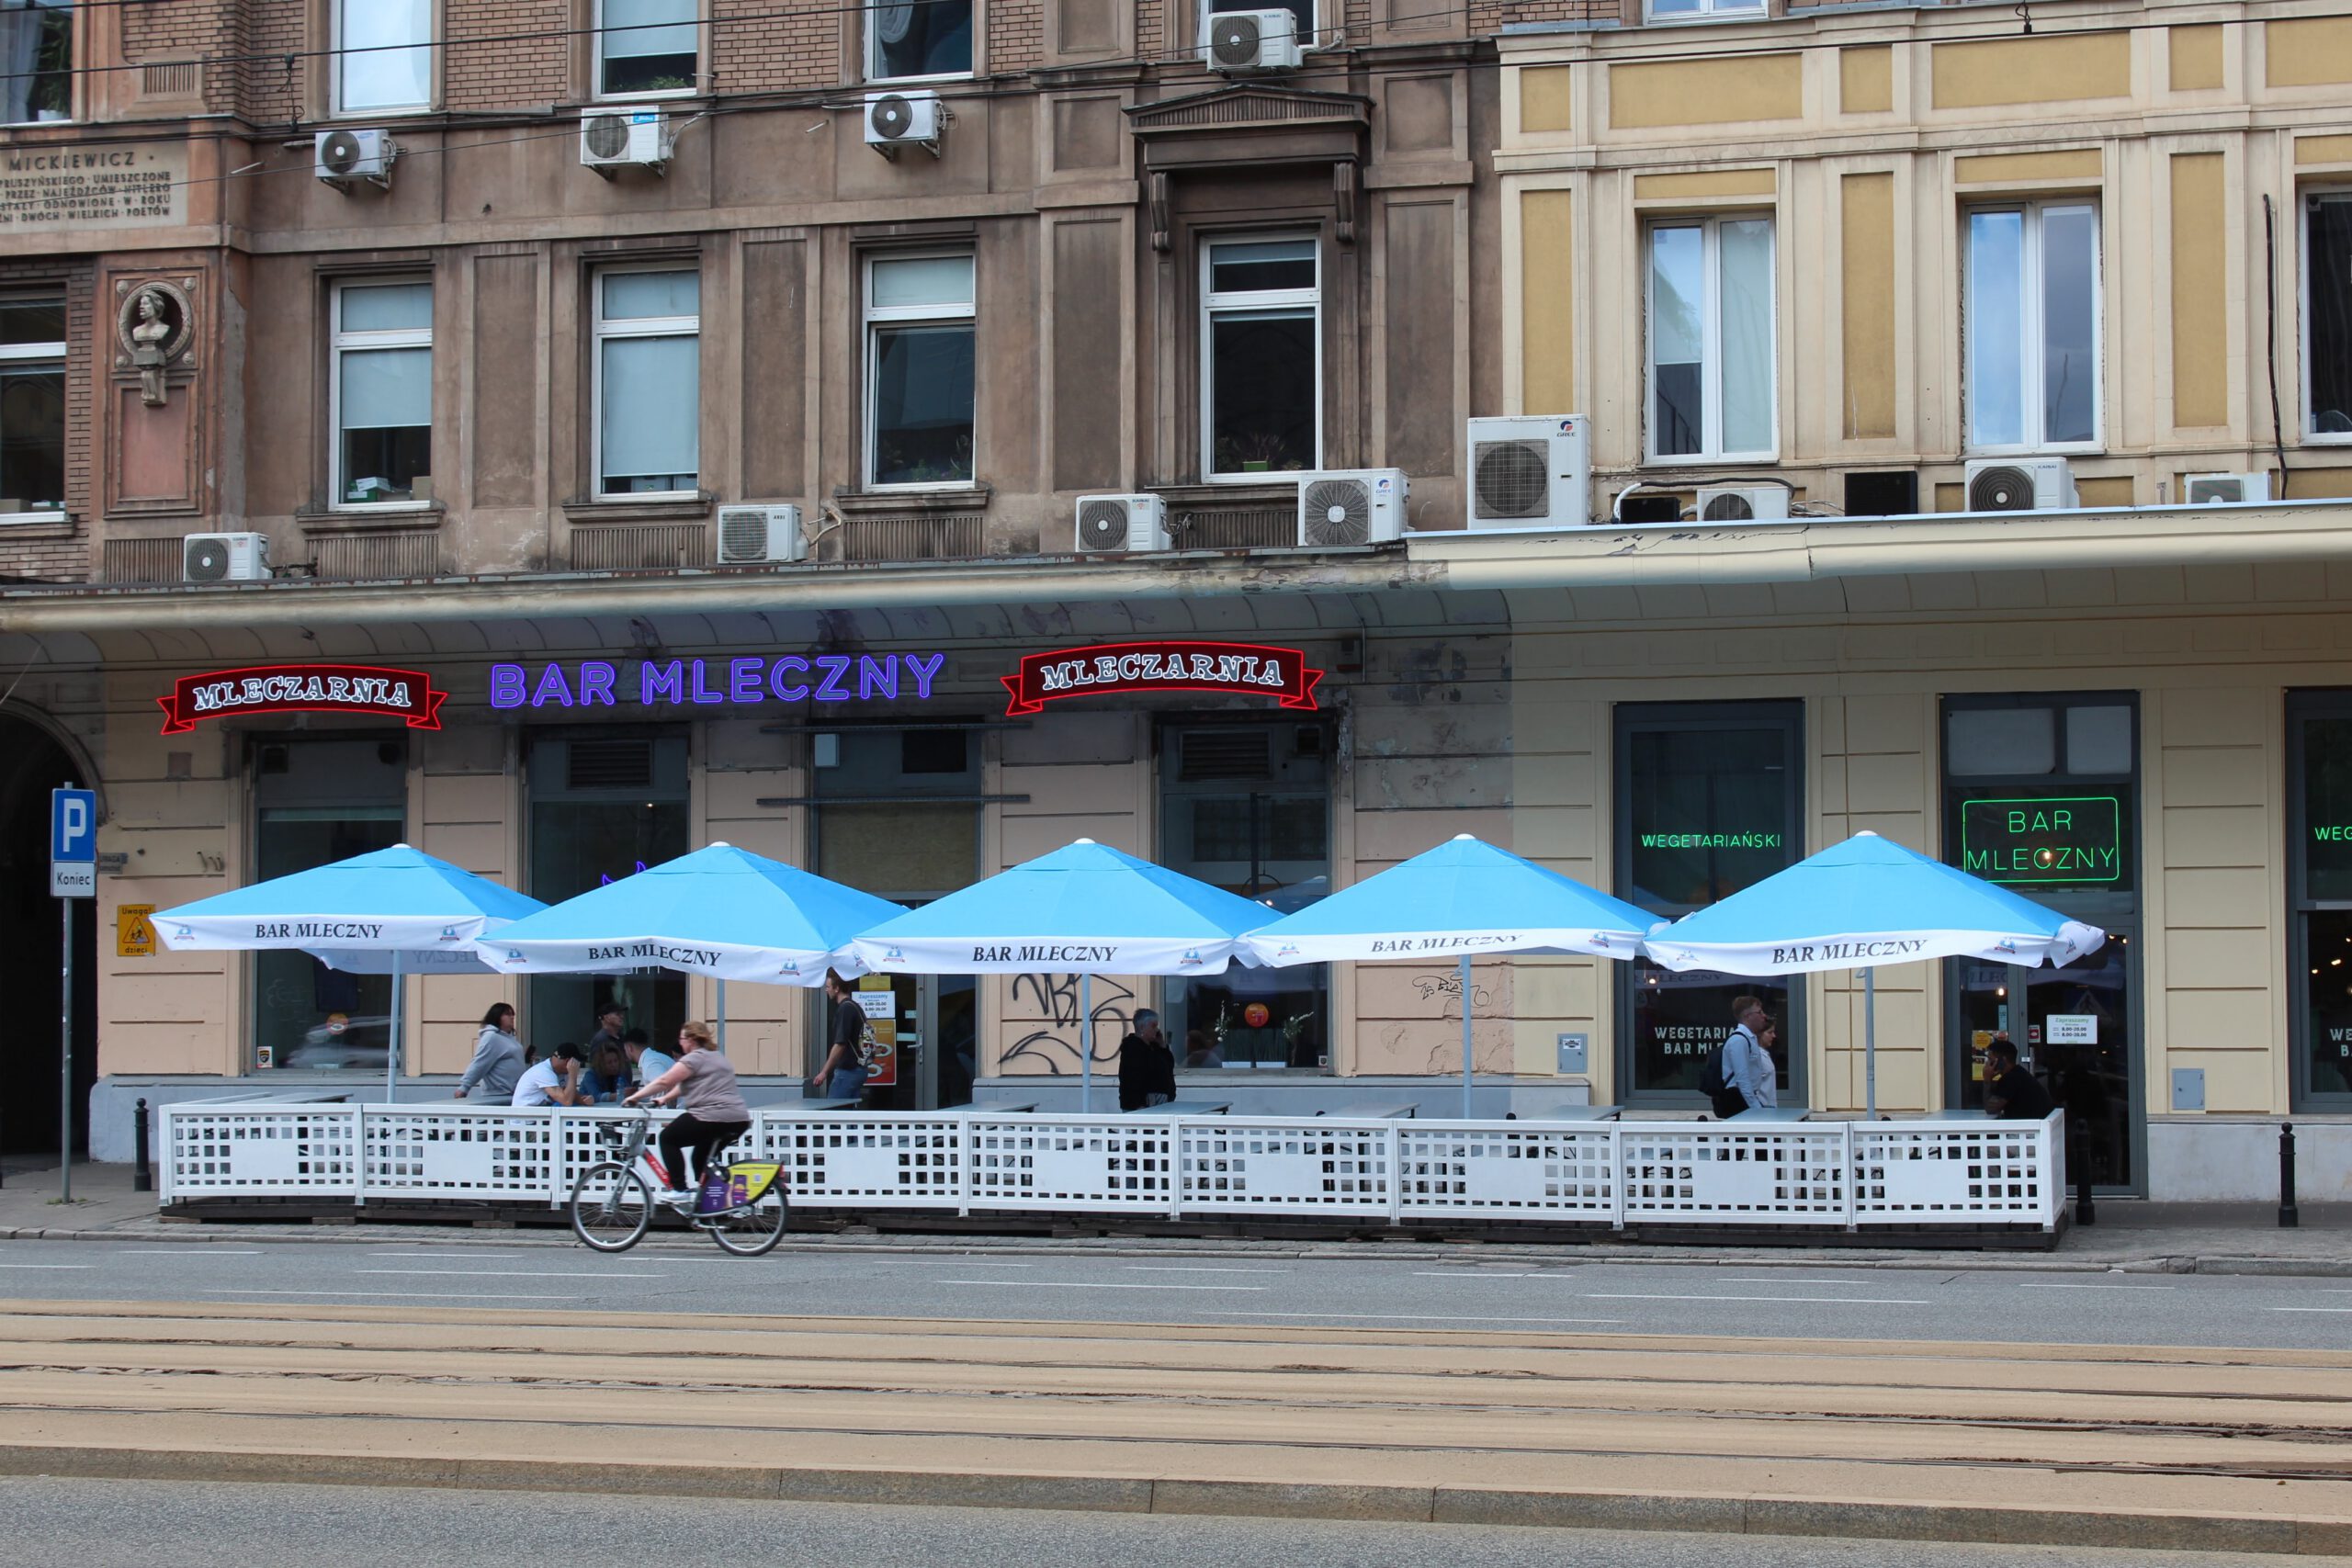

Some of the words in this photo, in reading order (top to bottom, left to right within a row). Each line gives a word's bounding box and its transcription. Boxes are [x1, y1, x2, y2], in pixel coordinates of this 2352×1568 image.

[8, 152, 135, 171] MICKIEWICZ
[93, 172, 171, 184] UMIESZCZONE
[6, 189, 35, 199] PRZEZ
[44, 197, 115, 209] ODNOWIONE
[123, 197, 131, 205] W
[141, 194, 171, 204] ROKU
[21, 211, 60, 221] DWÓCH
[68, 209, 119, 219] WIELKICH
[127, 205, 170, 217] POETÓW
[492, 661, 616, 708] BAR
[642, 653, 944, 705] MLECZNY
[1040, 653, 1284, 691] MLECZARNIA
[193, 676, 412, 710] MLECZARNIA
[63, 798, 86, 852] P
[2008, 810, 2072, 833] BAR
[1641, 830, 1781, 848] WEGETARIAŃSKI
[1967, 847, 2114, 871] MLECZNY
[57, 872, 90, 886] Koniec
[121, 907, 152, 917] Uwaga!
[255, 924, 290, 938] BAR
[295, 923, 383, 938] MLECZNY
[125, 946, 148, 954] dzieci
[1371, 940, 1413, 953] BAR
[1418, 934, 1524, 950] MLECZNY
[1771, 946, 1815, 964] BAR
[1819, 939, 1928, 961] MLECZNY
[588, 946, 626, 960] BAR
[631, 944, 722, 966] MLECZNY
[972, 946, 1012, 962] BAR
[1017, 946, 1118, 962] MLECZNY
[1664, 1043, 1691, 1055] BAR
